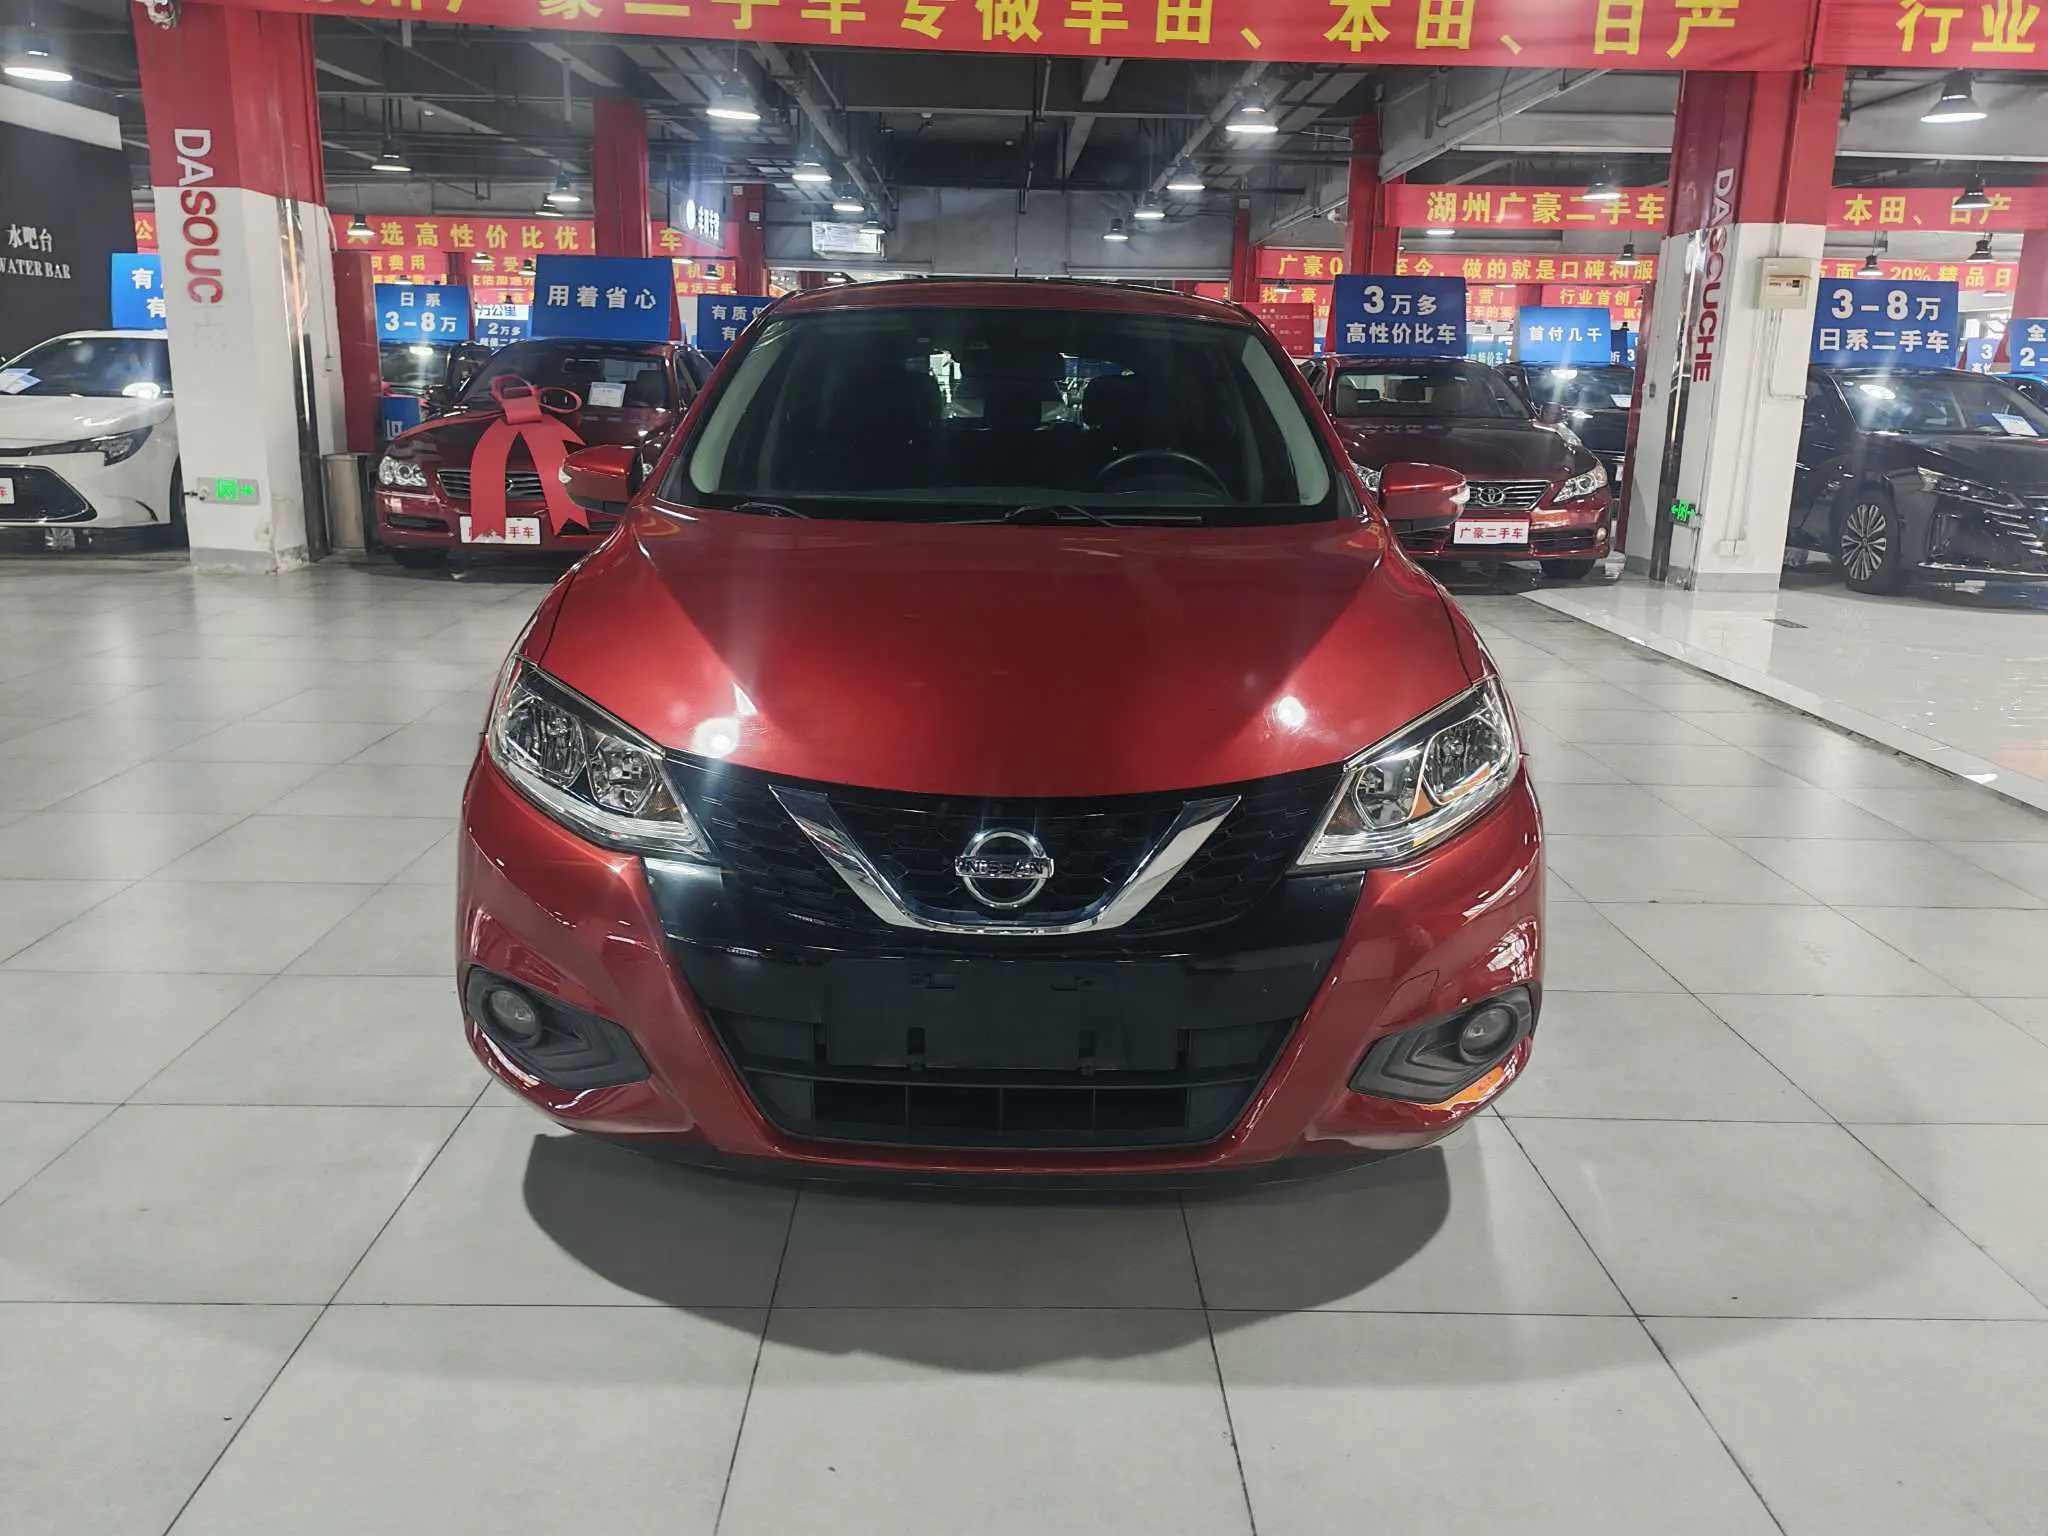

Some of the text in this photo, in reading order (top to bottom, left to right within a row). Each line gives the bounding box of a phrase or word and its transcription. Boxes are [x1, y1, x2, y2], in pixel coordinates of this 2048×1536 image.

[1896, 0, 2041, 53] 行业
[1427, 192, 1665, 225] 湖州广豪二手车
[1843, 193, 2012, 226] 本田、日产
[8, 224, 52, 252] 水吧台
[44, 262, 71, 279] BAR
[1693, 168, 1734, 383] DASOUCHE
[401, 292, 441, 308] 日系
[547, 285, 657, 310] 用着省心
[1363, 286, 1437, 315] 3万多
[488, 322, 521, 336] 2万多
[1346, 322, 1457, 344] 高性价比车
[1529, 325, 1603, 342] 首付几千
[1819, 328, 1950, 353] 日系二手车
[1459, 527, 1524, 540] 广豪二手车
